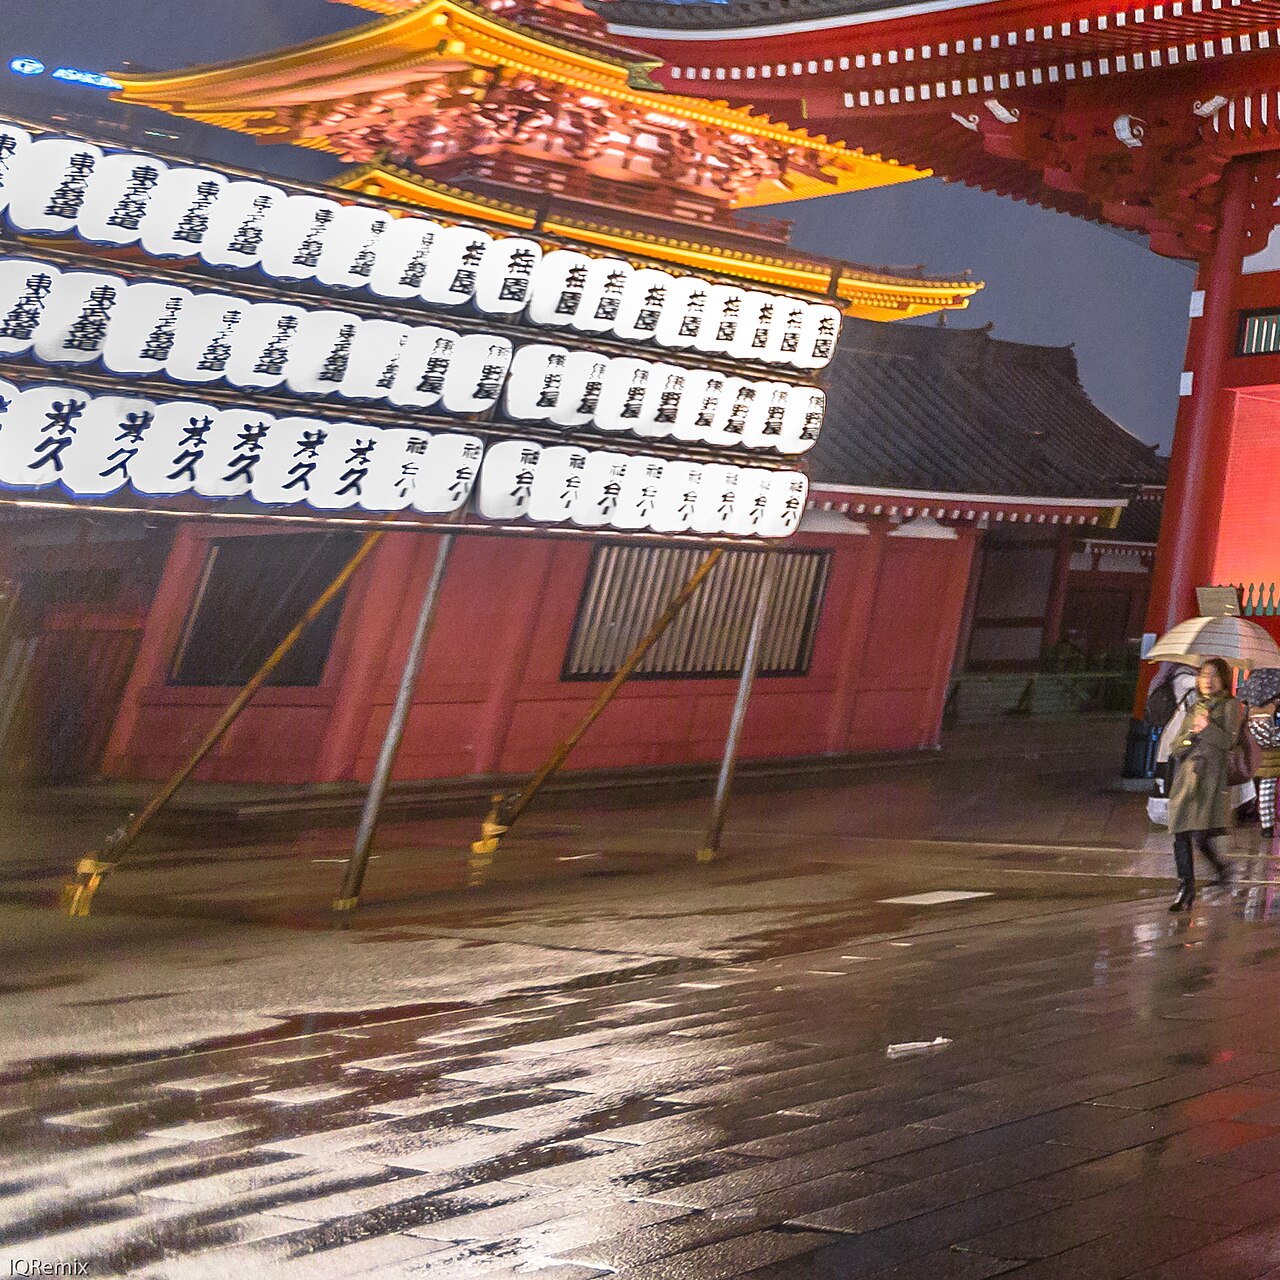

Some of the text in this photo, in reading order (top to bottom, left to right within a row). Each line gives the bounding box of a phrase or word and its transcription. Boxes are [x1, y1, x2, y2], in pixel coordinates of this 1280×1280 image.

[62, 284, 117, 352] 東武鉄道
[27, 398, 86, 472] 米久
[98, 410, 155, 479] 米久
[165, 415, 214, 482] 米久
[222, 421, 272, 484] 米久
[281, 429, 328, 491] 米久
[334, 437, 378, 496] 米久
